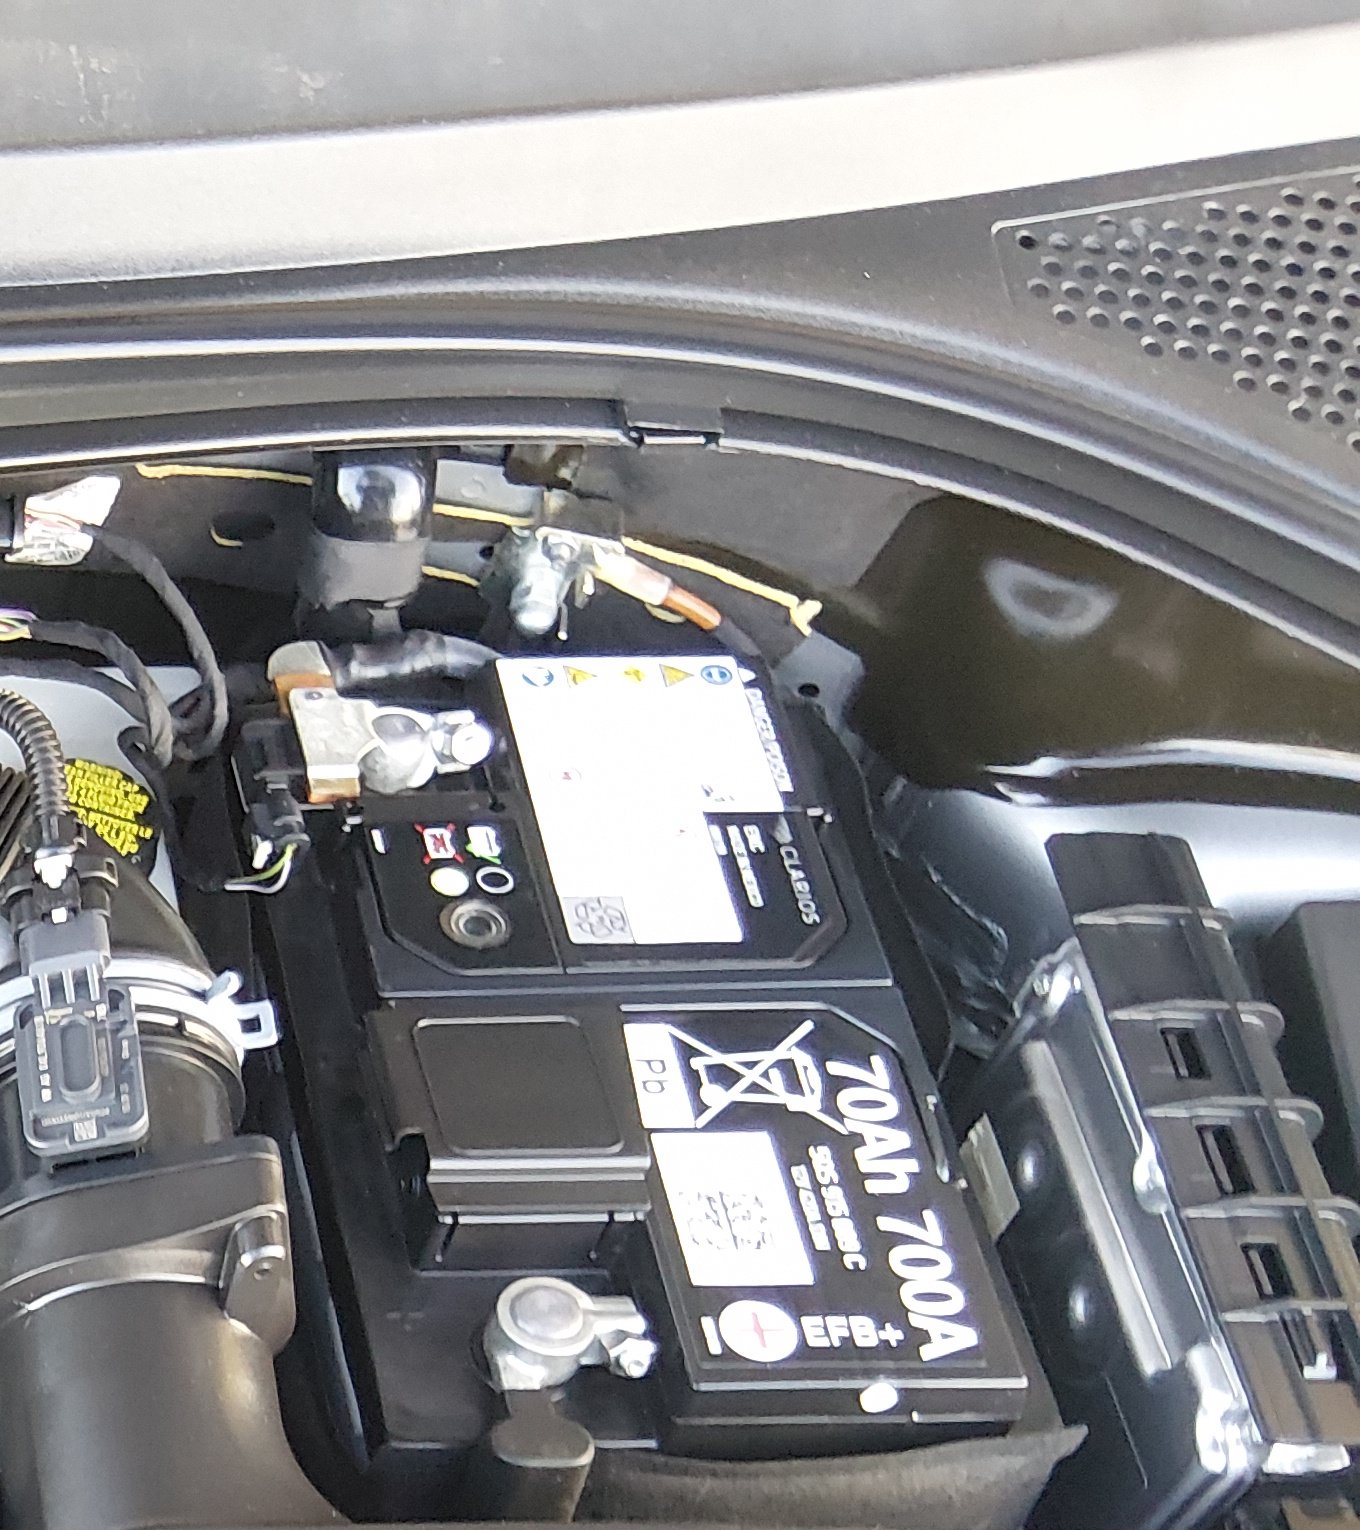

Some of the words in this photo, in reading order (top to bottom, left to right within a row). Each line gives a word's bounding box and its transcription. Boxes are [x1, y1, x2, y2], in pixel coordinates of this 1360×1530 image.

[779, 844, 818, 924] CLARIOS
[635, 1060, 668, 1092] Pb
[824, 1053, 924, 1197] 70Ah
[875, 1210, 979, 1362] 700A
[798, 1316, 904, 1348] EFB+
